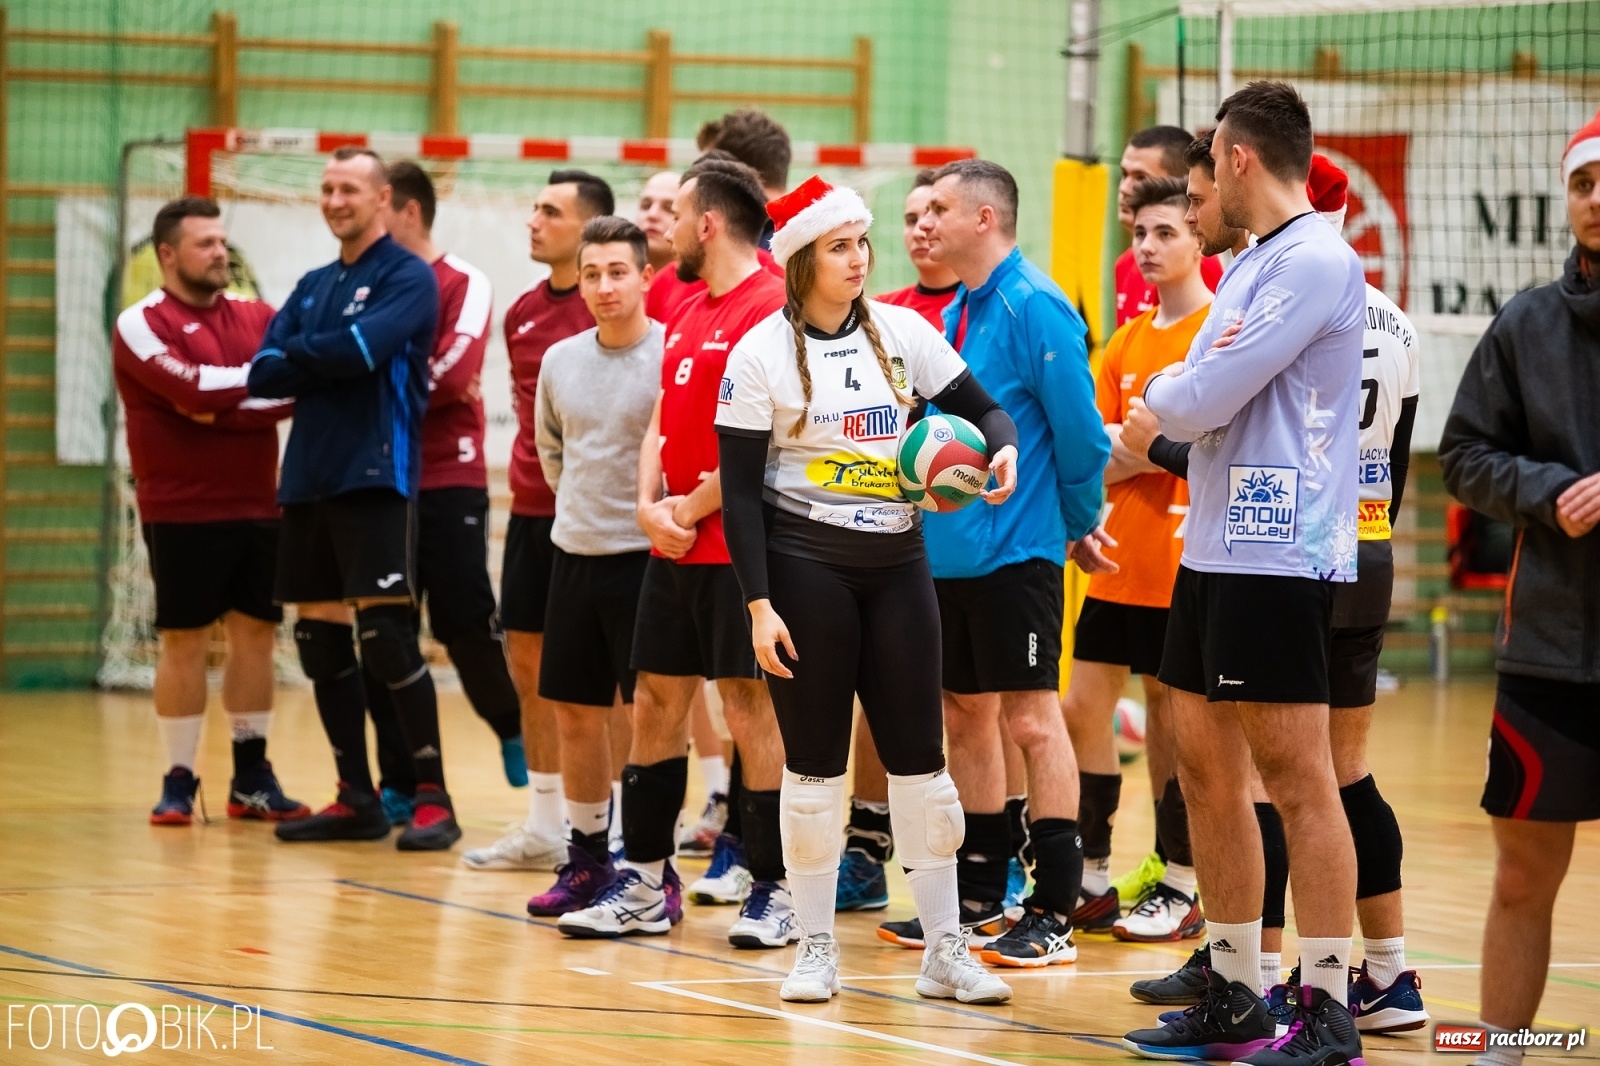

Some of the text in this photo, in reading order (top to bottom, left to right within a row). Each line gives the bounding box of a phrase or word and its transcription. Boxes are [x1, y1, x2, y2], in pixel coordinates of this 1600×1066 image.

[823, 348, 858, 359] regio
[674, 357, 694, 386] 8
[845, 366, 862, 391] 4
[814, 404, 898, 443] P.H.U. REMIX
[457, 436, 476, 463] 5
[952, 467, 984, 491] molten
[1211, 944, 1237, 954] adidas
[1314, 961, 1344, 970] adidas
